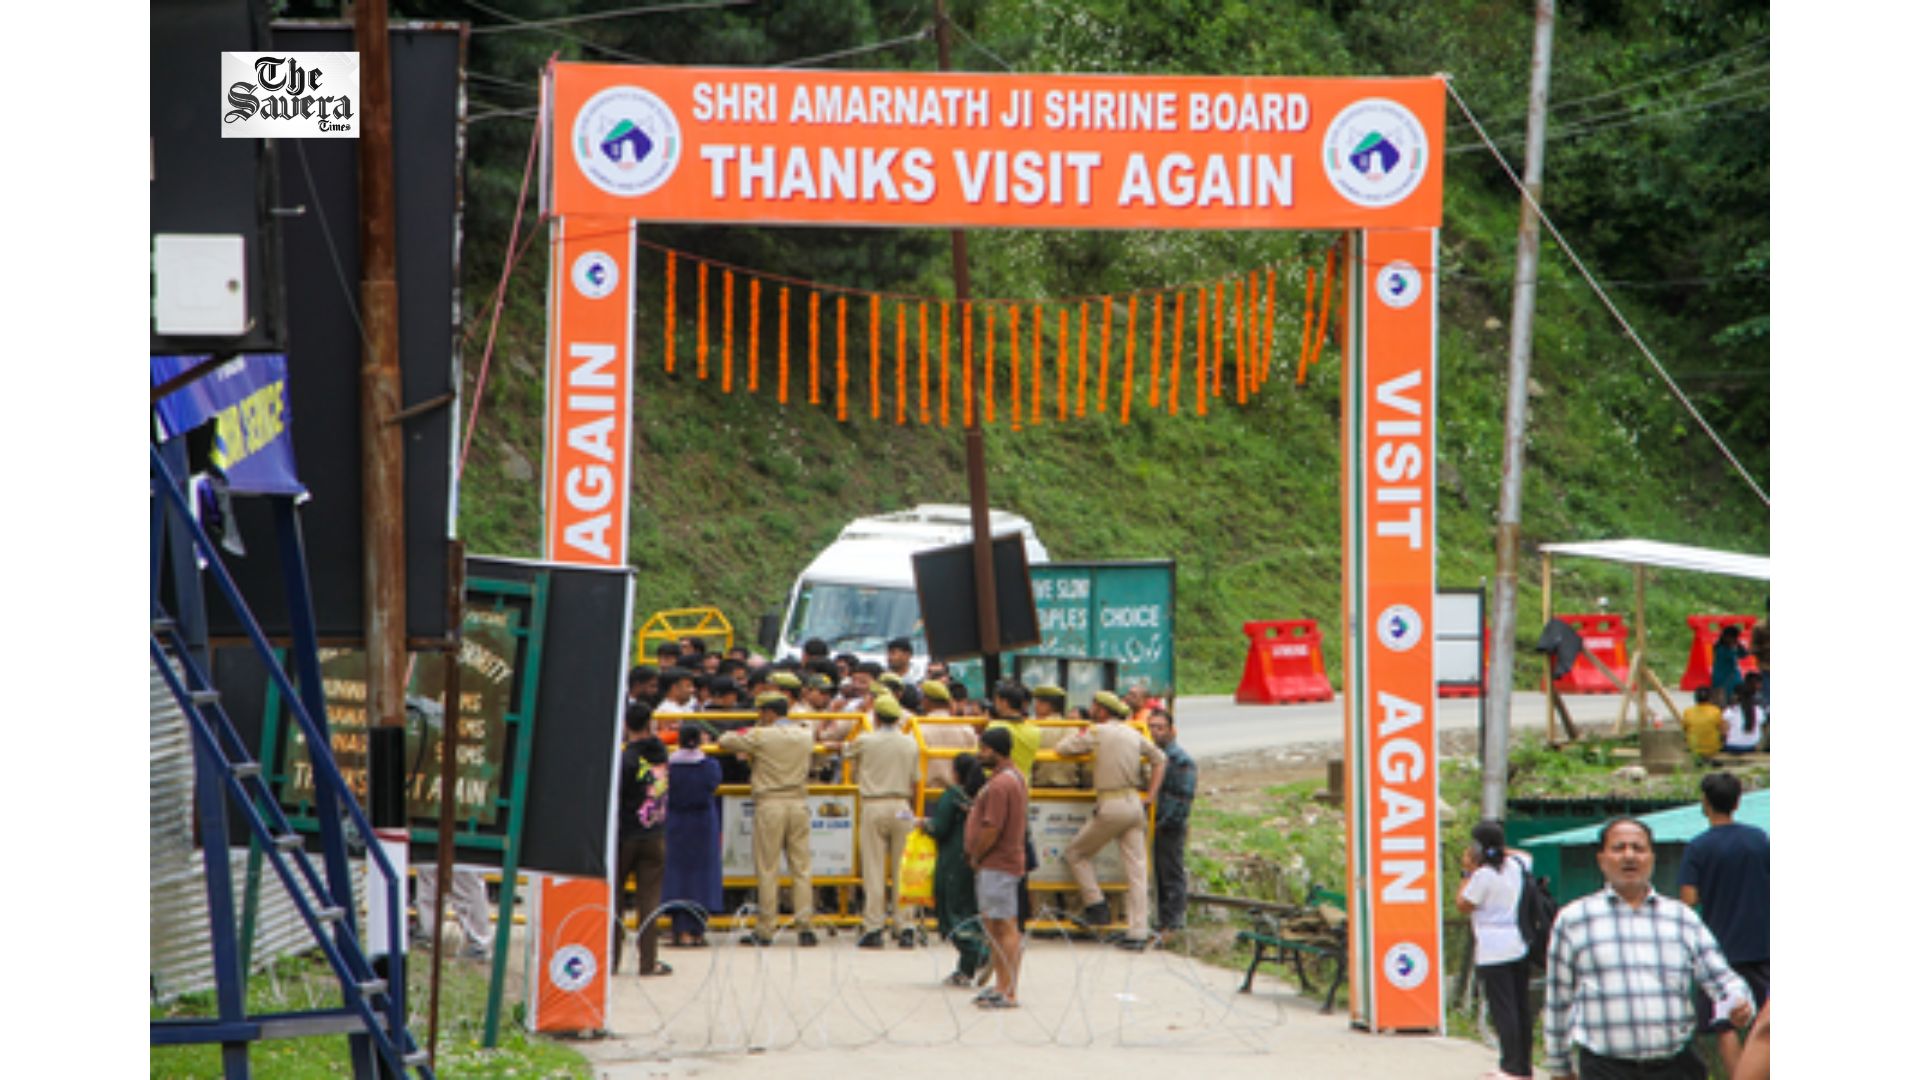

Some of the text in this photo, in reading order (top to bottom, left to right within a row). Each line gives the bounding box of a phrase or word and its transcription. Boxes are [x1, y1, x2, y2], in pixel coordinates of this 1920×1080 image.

[692, 82, 1309, 131] SHRI AMARNATH JI SHRINE BOARD
[700, 144, 936, 202] THANKS
[953, 149, 1100, 204] VISIT
[1118, 152, 1293, 207] AGAIN
[564, 343, 616, 561] AGAIN
[1376, 369, 1422, 550] VISIT
[1101, 605, 1159, 627] CHOICE
[1377, 690, 1427, 904] AGAIN
